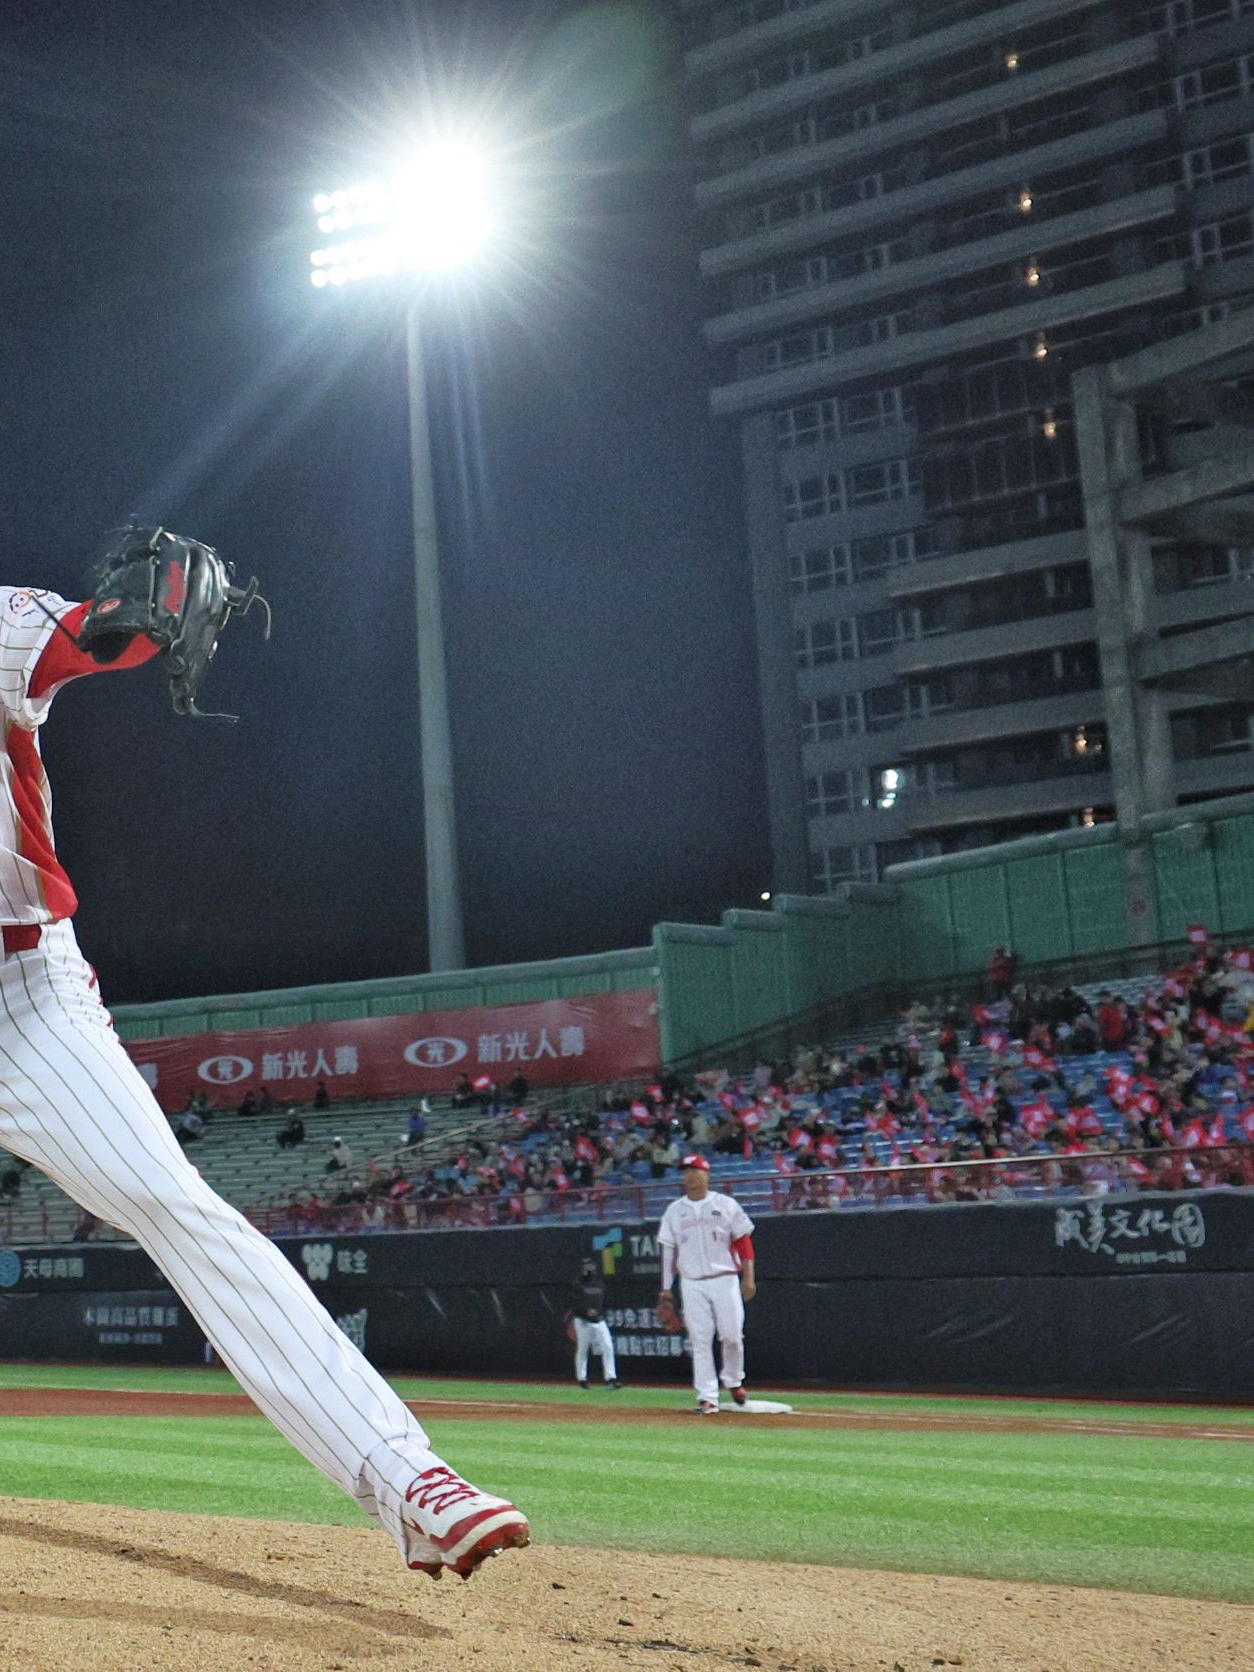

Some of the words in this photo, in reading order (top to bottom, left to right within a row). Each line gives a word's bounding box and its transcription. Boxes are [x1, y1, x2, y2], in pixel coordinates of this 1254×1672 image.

[262, 1045, 359, 1079] 新光人壽
[478, 1026, 585, 1063] 新光人壽
